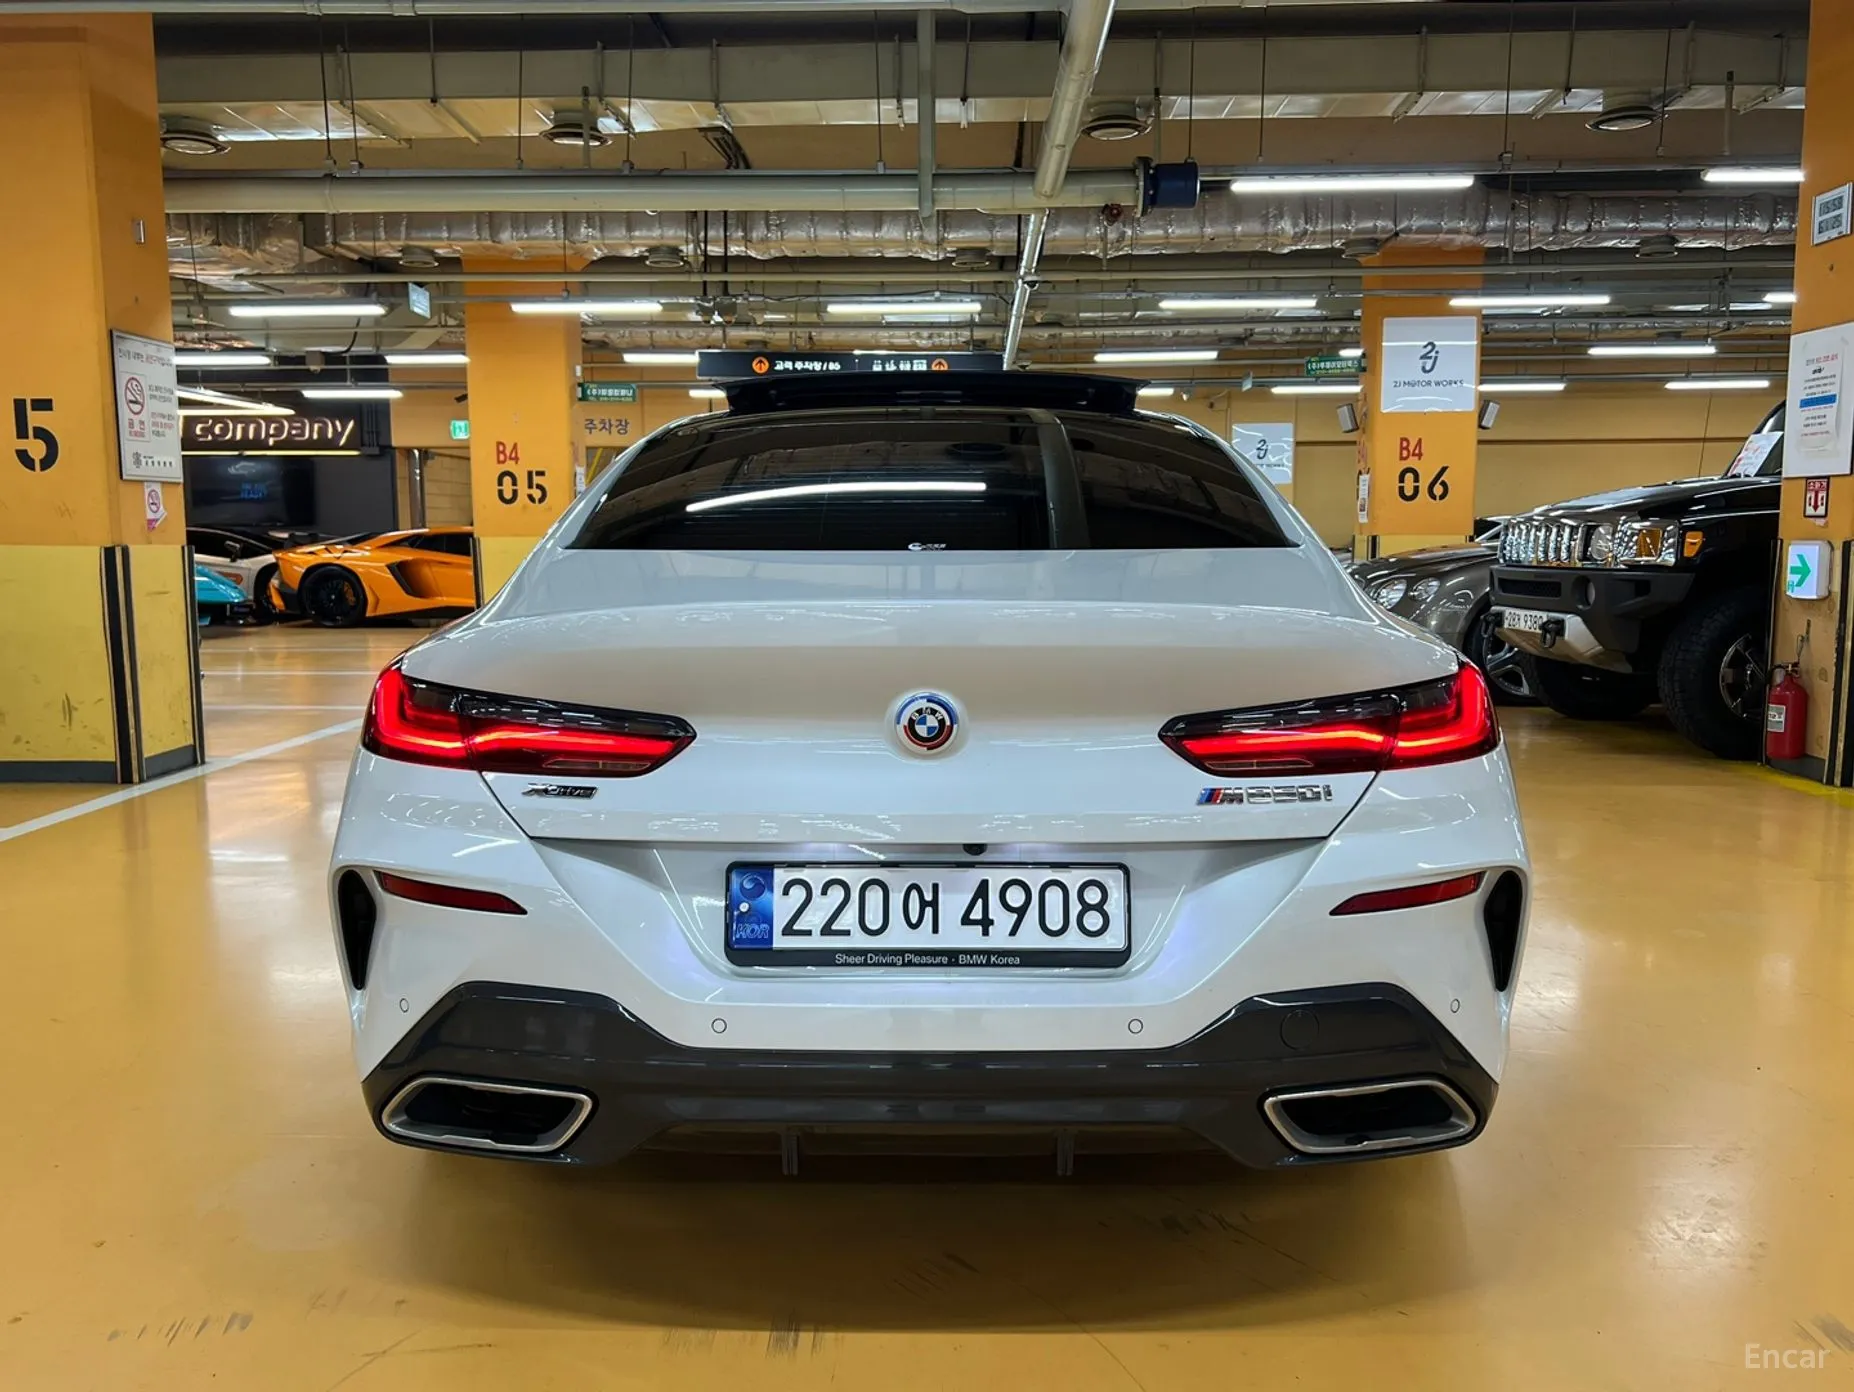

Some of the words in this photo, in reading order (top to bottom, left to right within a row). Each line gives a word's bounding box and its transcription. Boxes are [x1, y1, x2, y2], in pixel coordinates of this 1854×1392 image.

[12, 397, 60, 473] 5
[194, 417, 355, 447] company
[584, 417, 630, 436] 주차장
[496, 441, 520, 465] B4
[1399, 437, 1423, 461] B4
[496, 469, 548, 505] 05
[1398, 465, 1450, 502] 06
[911, 706, 944, 720] BMW
[780, 878, 940, 937] 220어
[960, 878, 1110, 938] 4908
[736, 923, 770, 939] KOR
[835, 953, 865, 964] Sheer
[867, 953, 903, 966] Driving
[905, 953, 949, 964] Pleasure
[958, 954, 987, 965] BMW
[990, 954, 1020, 965] Korea
